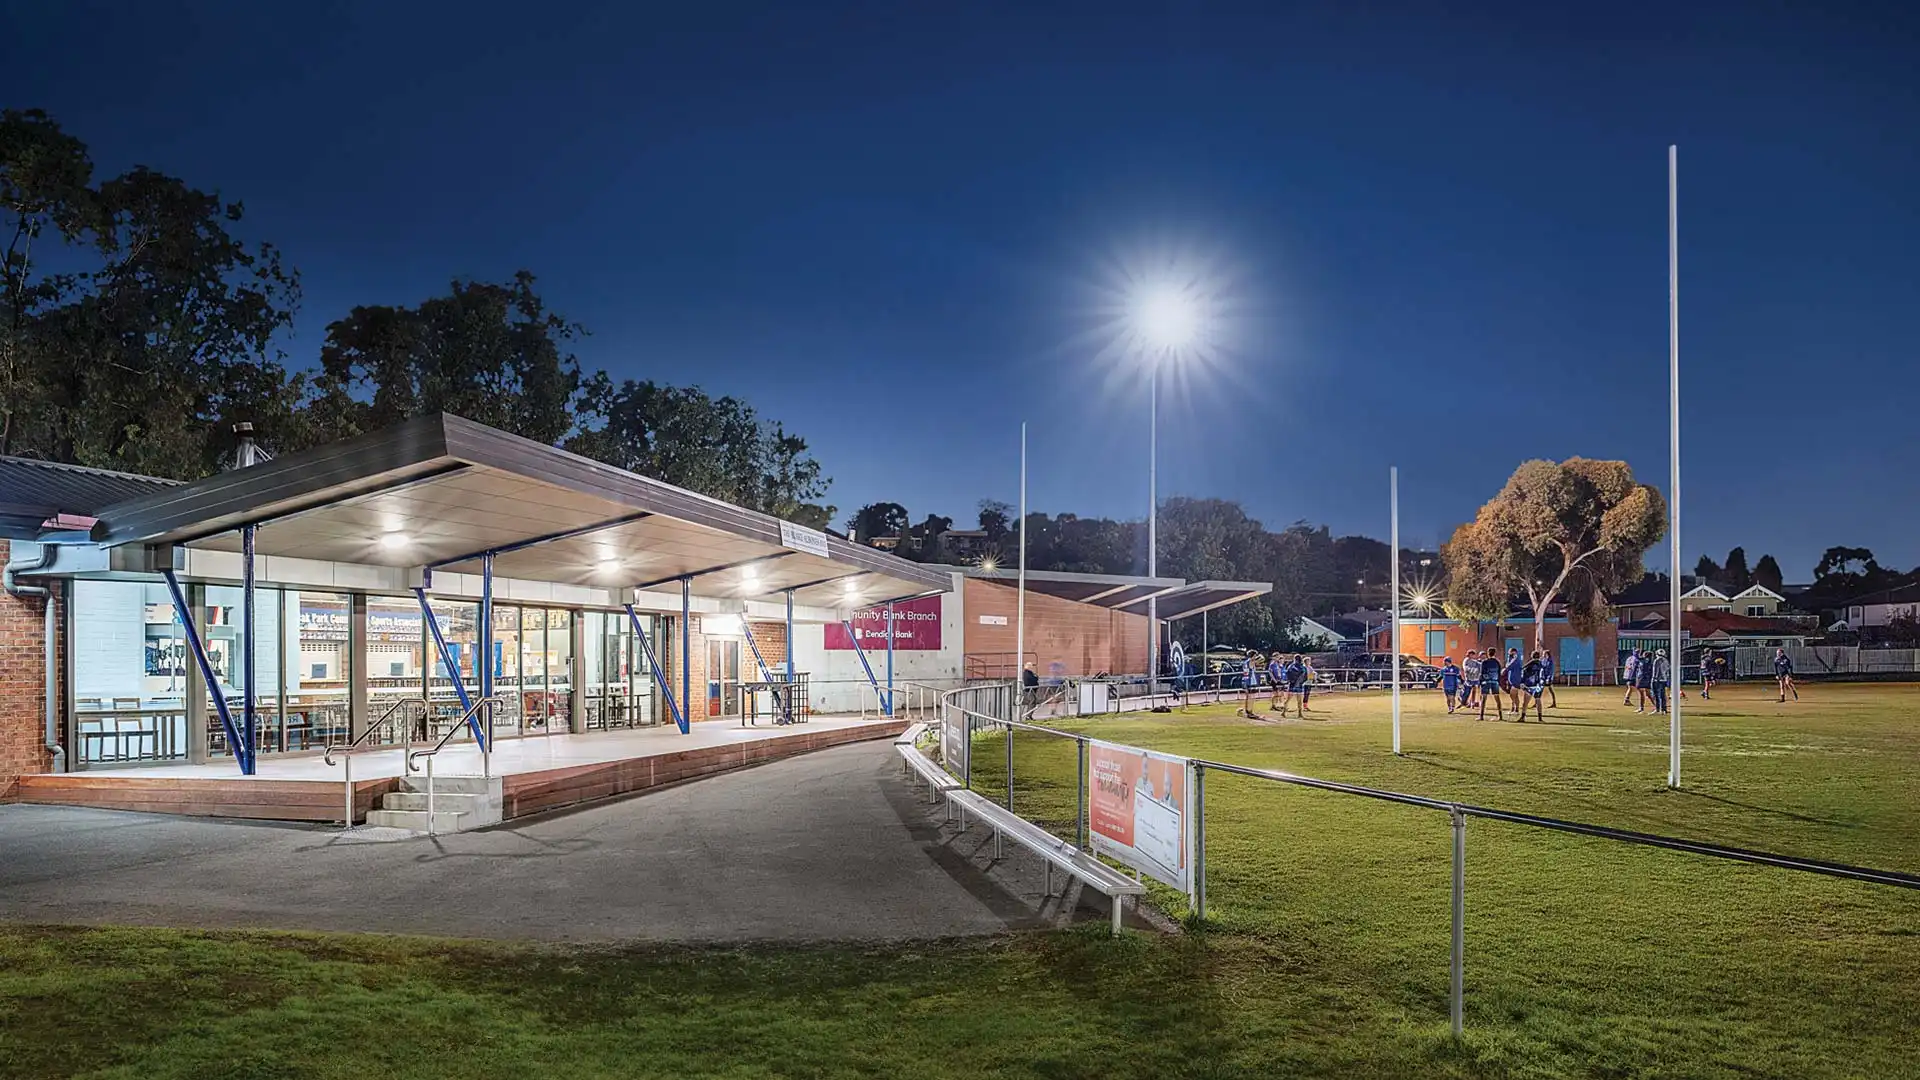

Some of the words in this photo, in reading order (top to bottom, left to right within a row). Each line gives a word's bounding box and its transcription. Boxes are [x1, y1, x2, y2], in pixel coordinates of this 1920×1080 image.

[907, 611, 937, 621] Branch
[865, 629, 894, 640] Bendig
[895, 630, 913, 638] Bank
